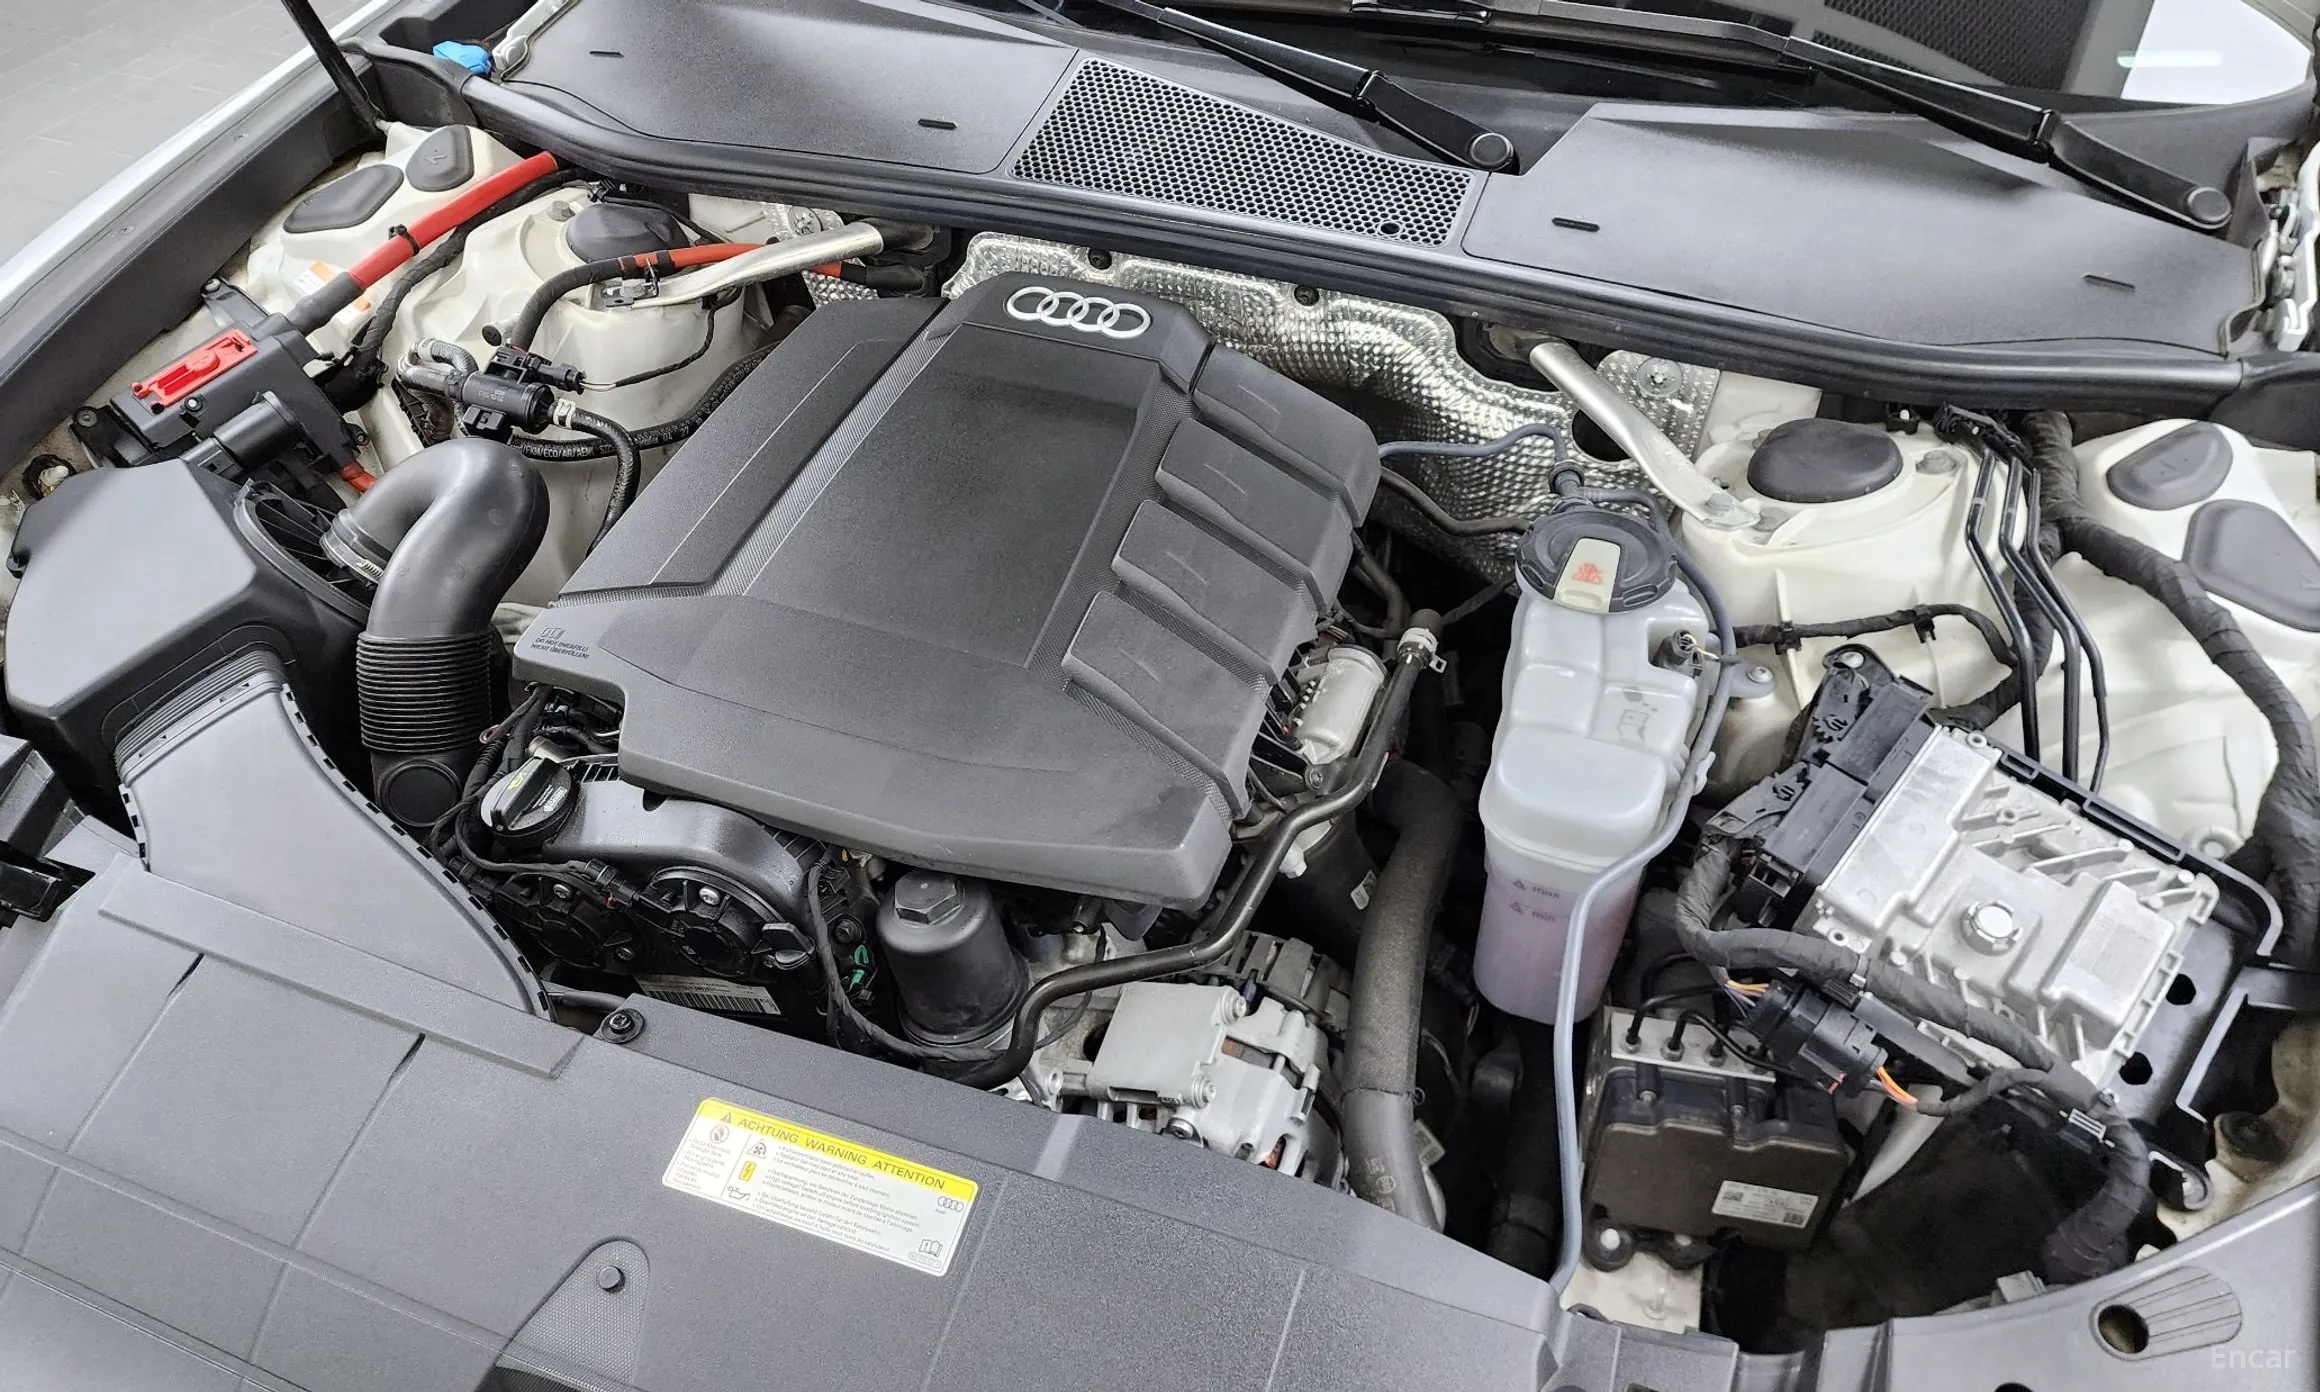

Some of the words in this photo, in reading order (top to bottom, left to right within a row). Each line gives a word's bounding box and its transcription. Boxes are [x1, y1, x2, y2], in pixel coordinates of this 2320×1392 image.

[737, 1118, 799, 1145] ACHTUNG
[805, 1137, 868, 1165] WARNING
[872, 1160, 946, 1190] ATTENTION
